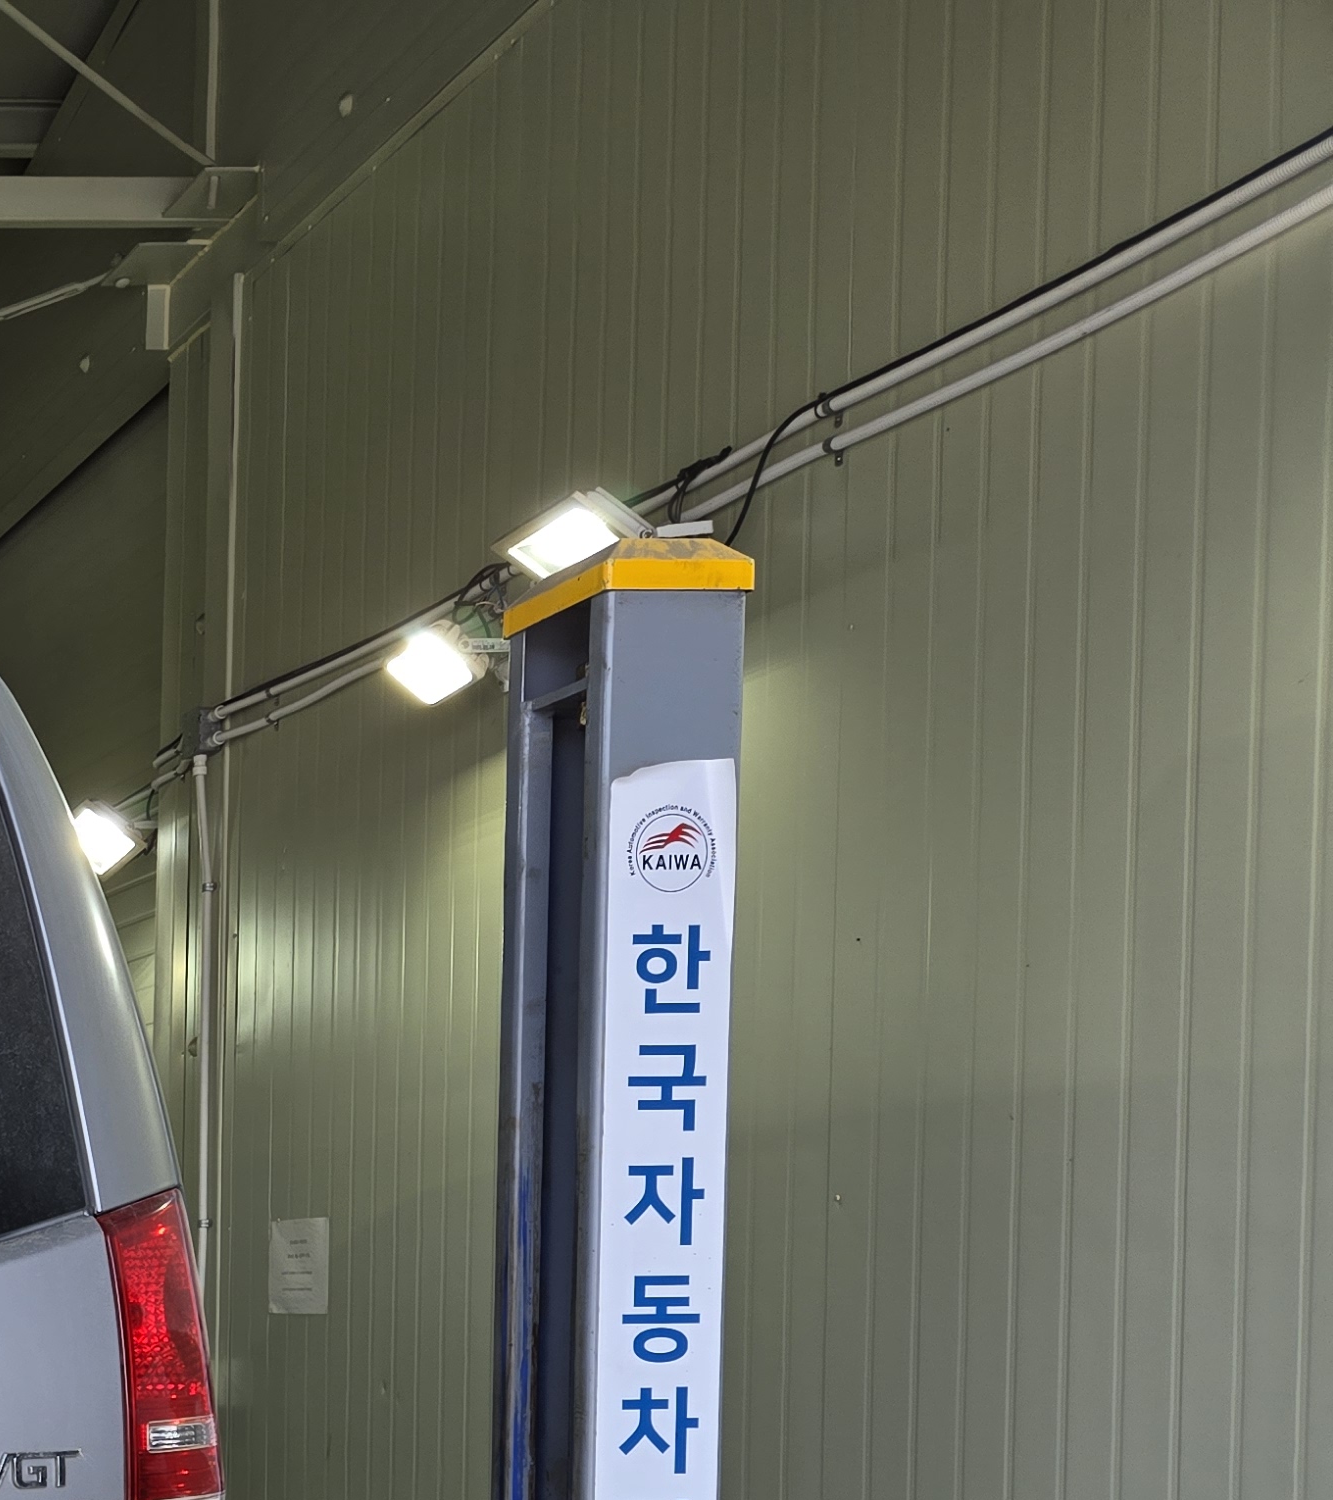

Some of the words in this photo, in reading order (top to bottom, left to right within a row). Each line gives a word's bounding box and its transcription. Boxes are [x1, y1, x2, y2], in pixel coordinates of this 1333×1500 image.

[627, 817, 646, 853] Automotive
[645, 804, 679, 819] Inspection
[680, 805, 692, 814] and
[692, 809, 713, 836] Warranty
[705, 838, 718, 878] Association
[642, 854, 702, 871] KAIWA
